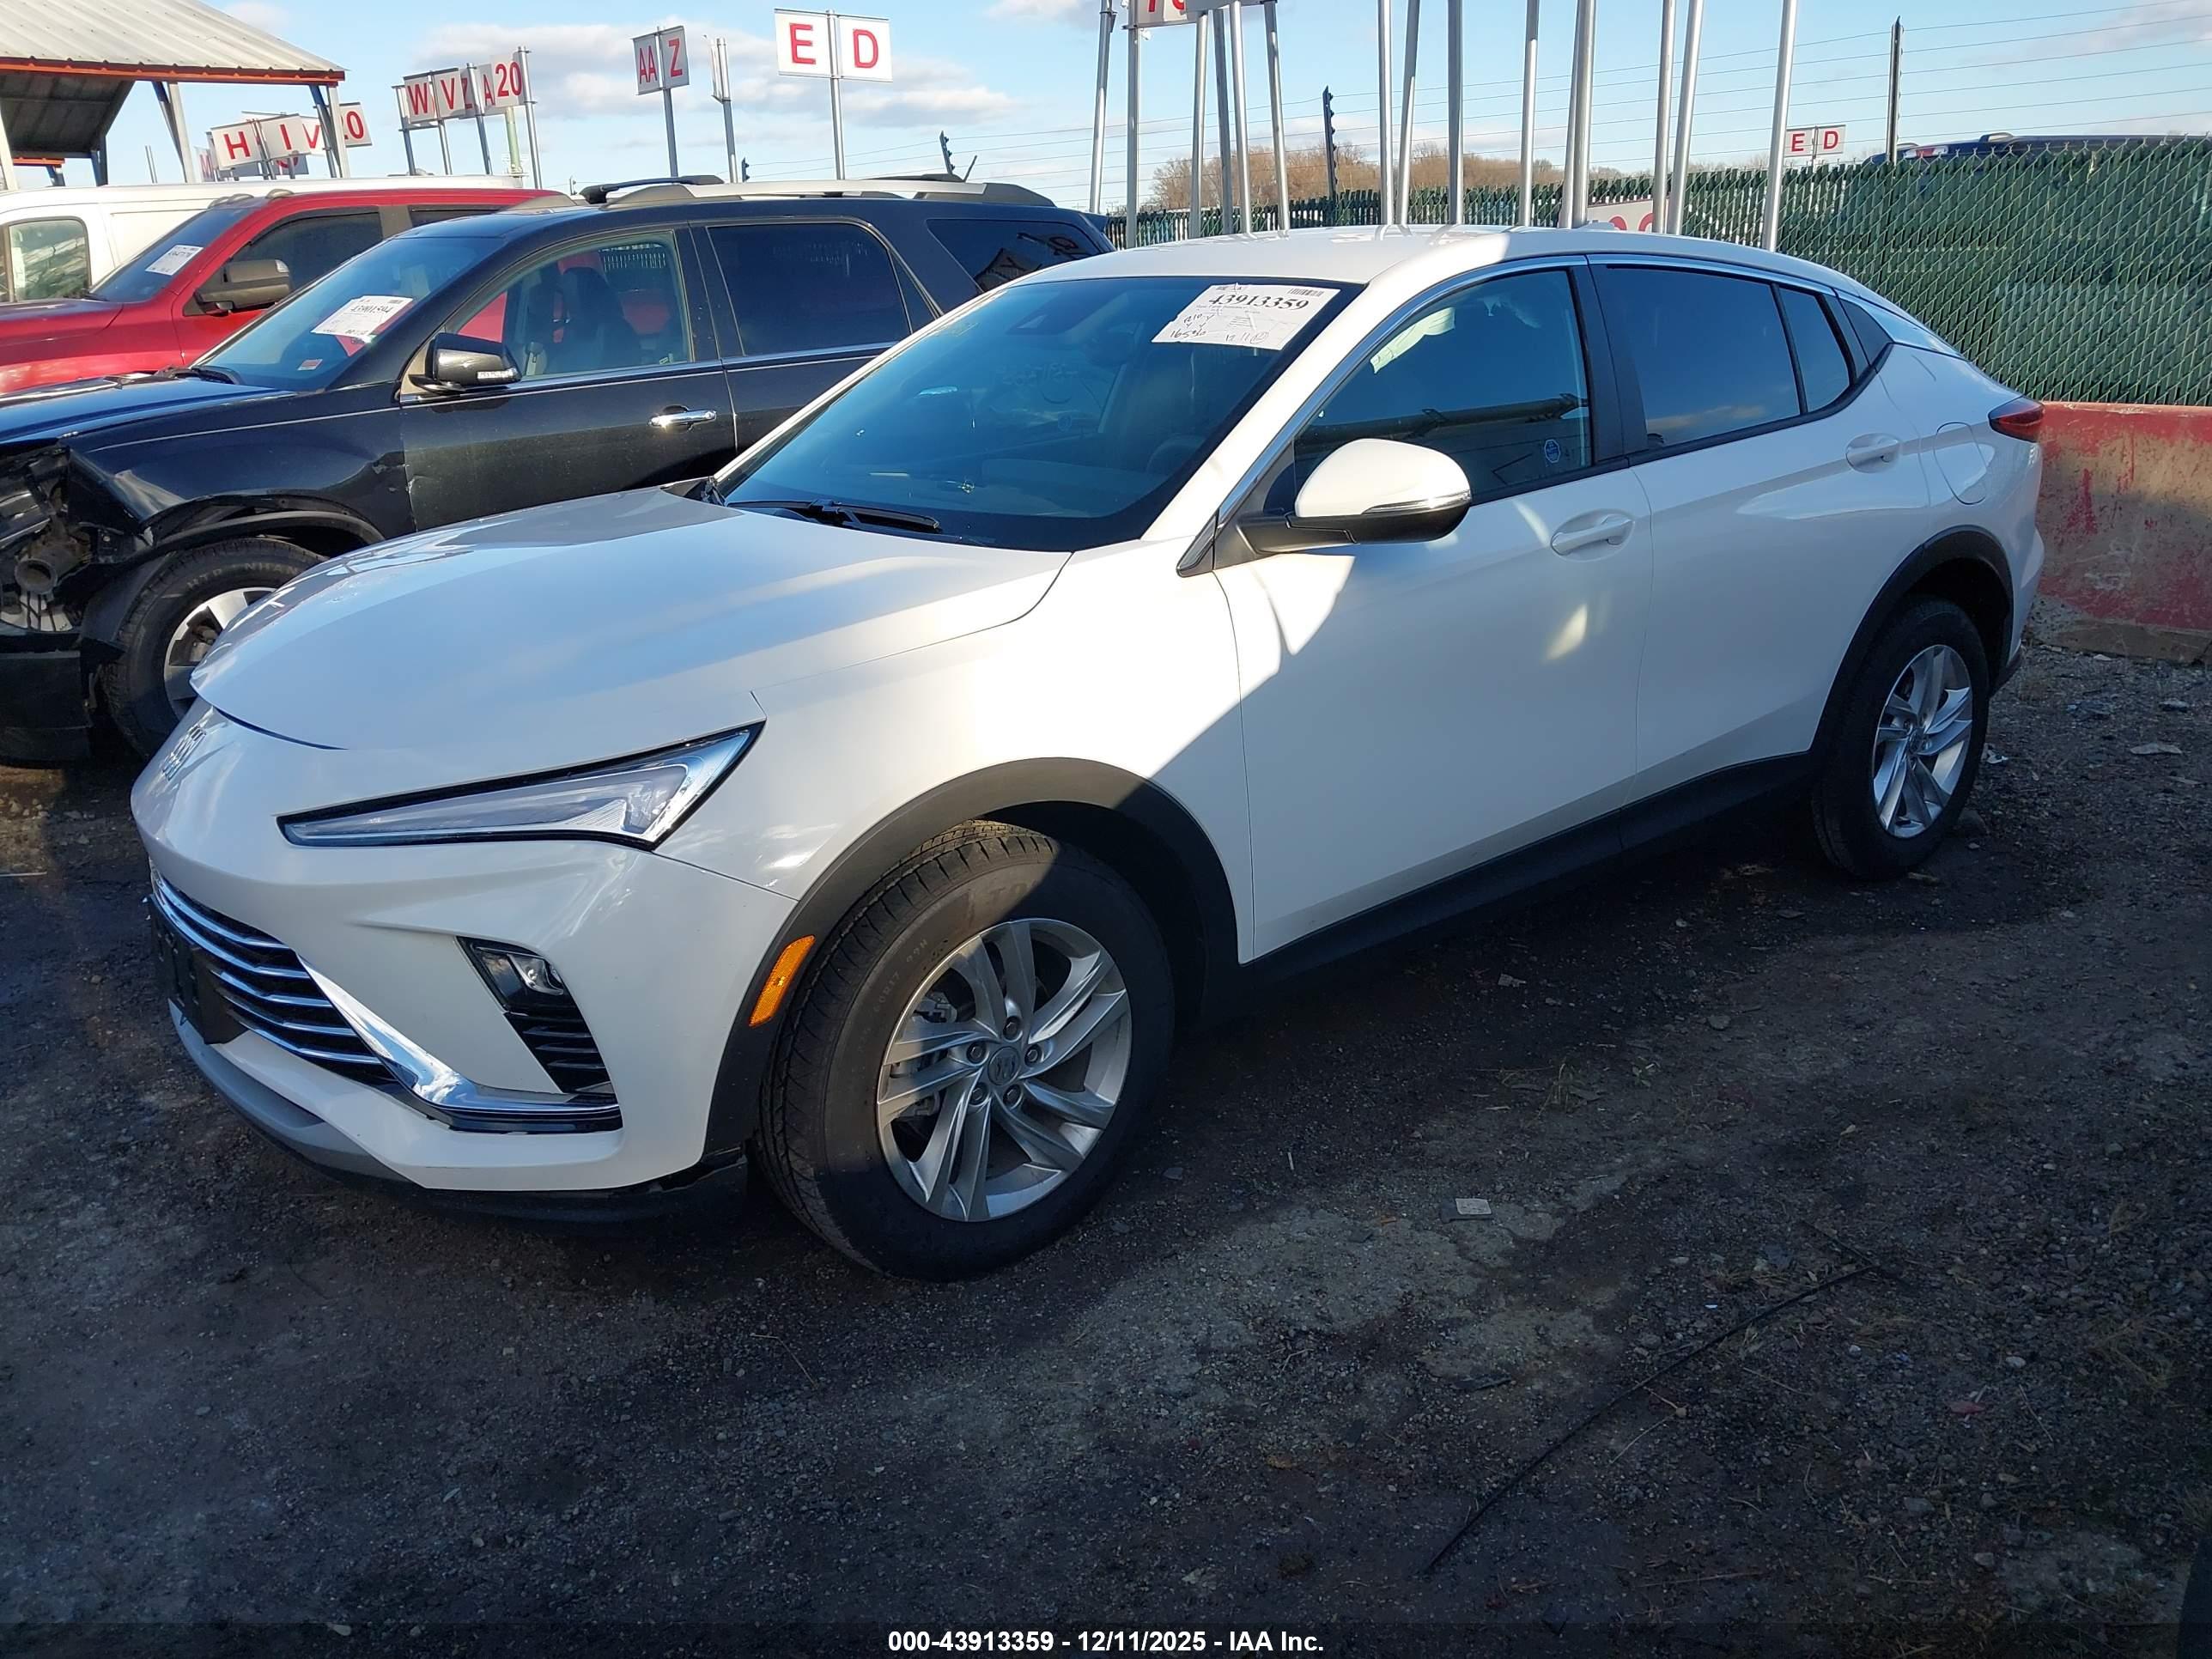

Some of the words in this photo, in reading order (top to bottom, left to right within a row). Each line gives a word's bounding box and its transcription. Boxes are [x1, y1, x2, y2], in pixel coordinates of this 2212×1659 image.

[639, 46, 658, 84] AA
[668, 39, 683, 77] Z
[789, 22, 816, 65] E
[853, 28, 879, 69] D
[495, 61, 523, 97] 20
[407, 82, 428, 115] W
[440, 77, 455, 110] V
[341, 111, 364, 139] 0
[223, 131, 251, 160] H
[1791, 132, 1805, 152] E
[1823, 131, 1838, 150] D
[1209, 294, 1310, 311] 43913359
